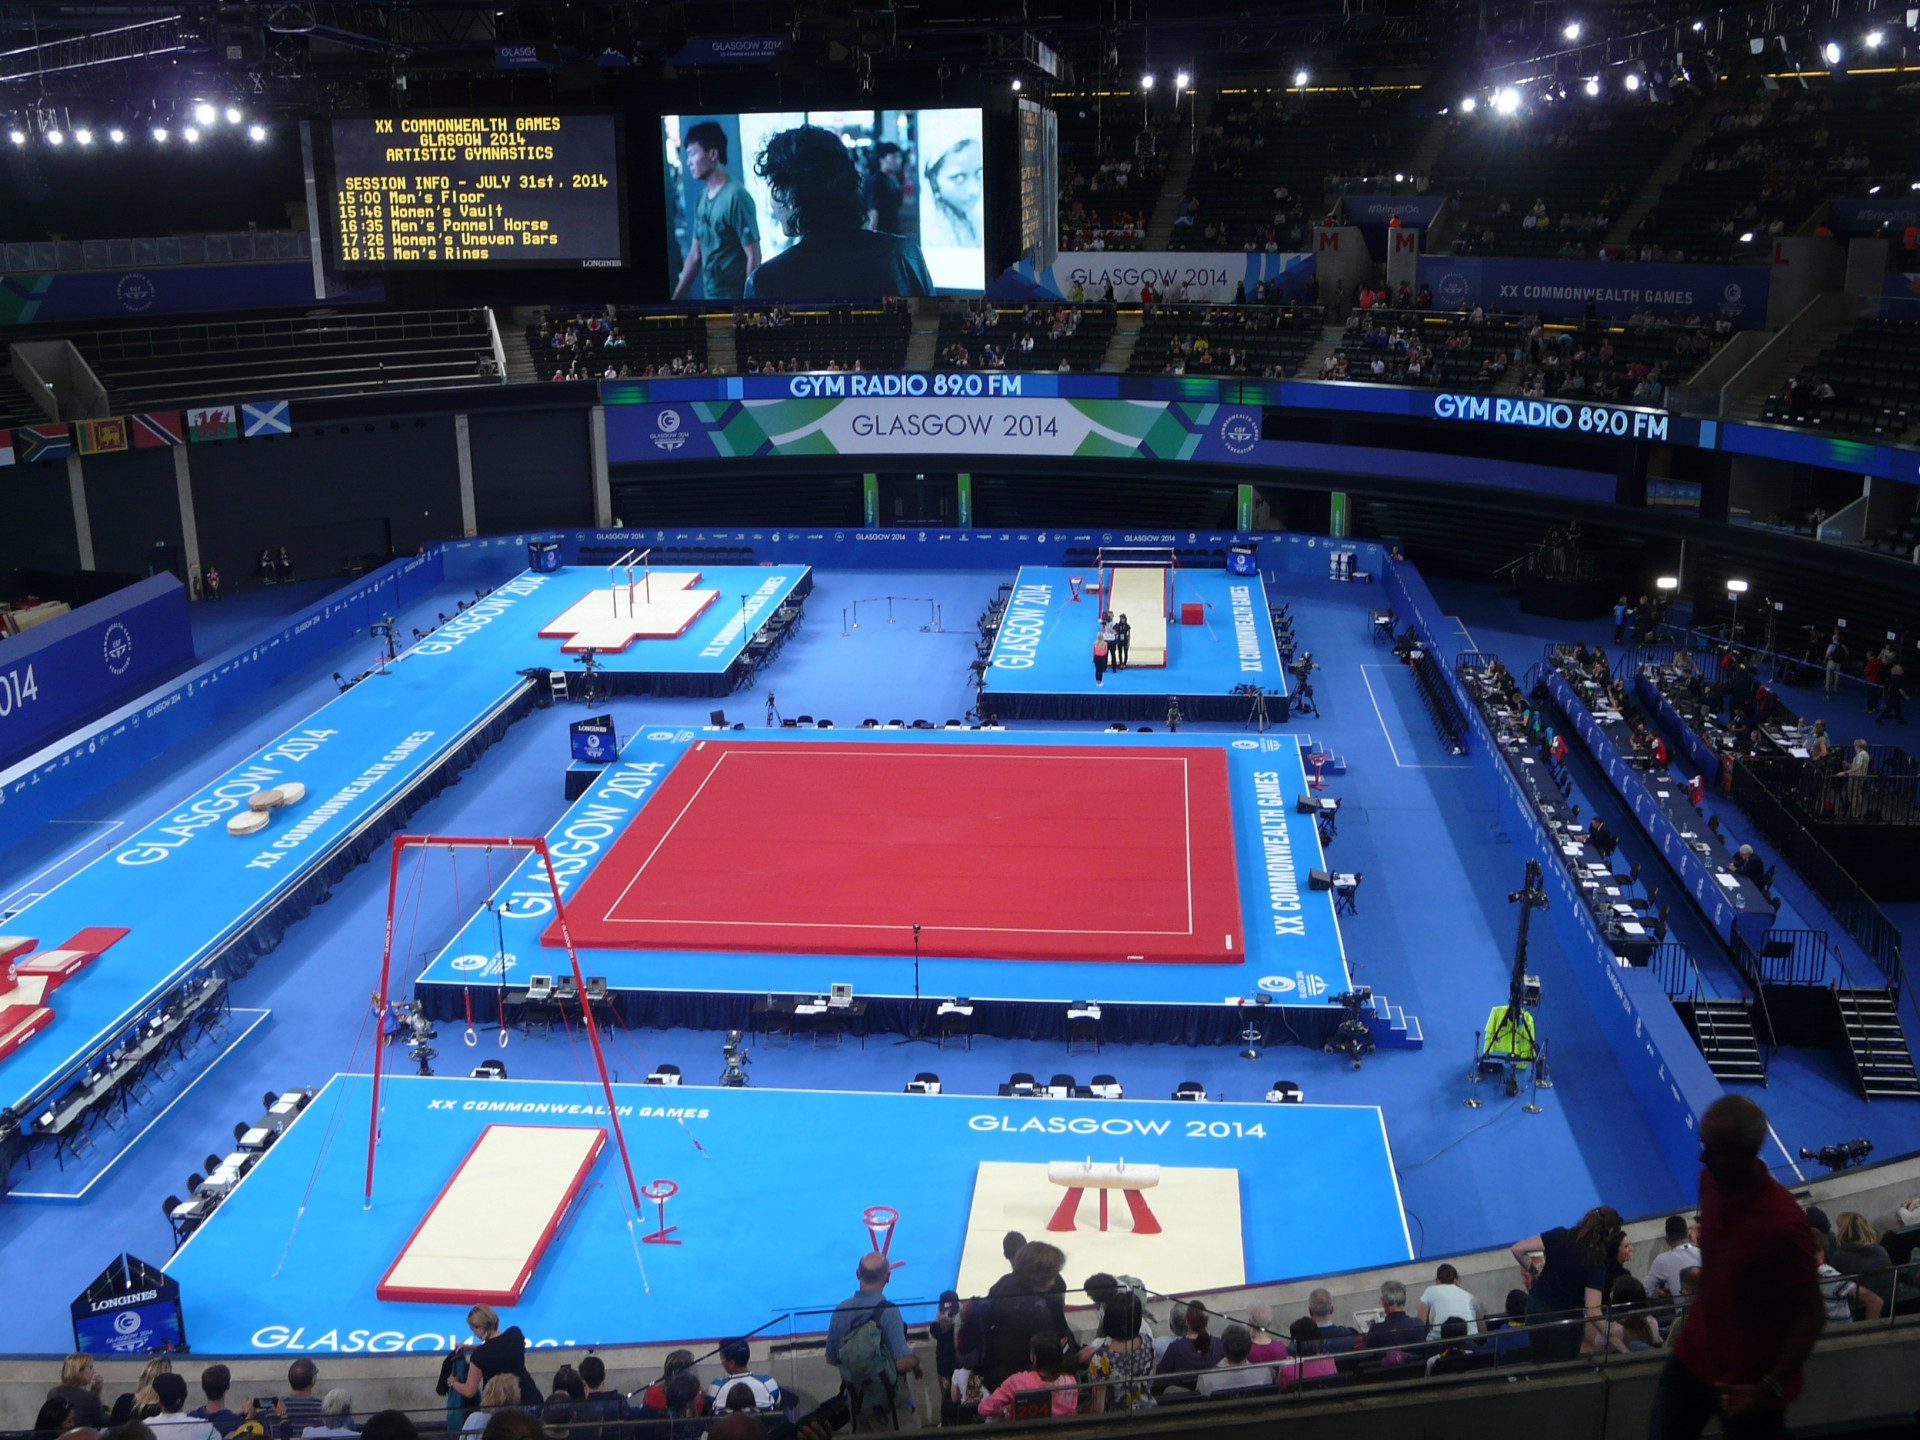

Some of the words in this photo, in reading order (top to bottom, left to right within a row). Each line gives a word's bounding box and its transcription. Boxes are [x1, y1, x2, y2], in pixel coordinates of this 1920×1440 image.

[375, 120, 393, 133] XX
[401, 118, 507, 133] COMMONWEALTH
[516, 117, 561, 131] GAMES
[420, 133, 482, 147] GLASGOW
[490, 132, 526, 146] 2014
[386, 147, 456, 162] ARTISTIC
[465, 146, 553, 160] GYMNASTICS
[345, 176, 406, 190] SESSION
[415, 175, 449, 189] INFO
[475, 175, 511, 189] JULY
[572, 174, 608, 188] 2014
[338, 191, 381, 204] 15:00
[389, 190, 433, 204] Men's
[441, 190, 485, 203] Floor
[339, 205, 382, 219] 15:46
[390, 205, 451, 218] Women's
[460, 204, 503, 218] Vault
[341, 219, 383, 233] 16:35
[392, 219, 435, 232] Men's
[443, 218, 494, 231] Pommel
[504, 218, 549, 231] Horse
[341, 233, 384, 246] 17:26
[392, 232, 453, 246] Women's
[461, 232, 513, 245] Uneven
[522, 231, 558, 245] Bars
[1320, 232, 1338, 250] M
[1395, 233, 1415, 253] M
[343, 247, 385, 260] 18:15
[393, 247, 437, 260] Men's
[445, 246, 489, 260] Rings
[582, 259, 622, 267] LONGINES
[1774, 242, 1789, 264] L
[1071, 268, 1182, 286] GLASGOW
[1186, 269, 1228, 286] 2014
[1500, 284, 1519, 299] XX
[1523, 285, 1640, 304] COMMONWEALTH
[1643, 289, 1694, 305] GAMES
[789, 373, 845, 398] GYM
[851, 373, 929, 397] RADIO
[933, 373, 983, 397] 89.0
[988, 375, 1022, 397] FM
[852, 413, 993, 438] GLASGOW
[1003, 414, 1059, 438] 2014
[1434, 394, 1490, 421] GYM
[1495, 399, 1573, 430] RADIO
[1578, 407, 1629, 436] 89.0
[1634, 413, 1669, 441] FM
[596, 532, 629, 540] GLASGOW
[631, 532, 645, 540] 2014
[856, 533, 890, 541] GLASGOW
[891, 533, 906, 541] 2014
[1124, 534, 1160, 542] GLASGOW
[1161, 534, 1176, 542] 2014
[416, 596, 514, 656] GLASGOW
[498, 575, 551, 597] 2014
[993, 614, 1046, 669] GLASGOW
[1021, 583, 1053, 612] 2014
[147, 699, 171, 719] GLASGOW
[115, 766, 283, 866] GLASGOW
[263, 728, 339, 762] 2014
[1253, 771, 1284, 807] GAMES
[245, 852, 287, 870] XX
[272, 762, 396, 850] COMMONWEALTH
[382, 730, 436, 762] GAMES
[499, 804, 628, 919] GLASGOW
[598, 761, 665, 800] 2014
[1259, 809, 1302, 911] COMMONWEALTH
[1273, 915, 1306, 936] XX
[426, 1099, 458, 1111] XX
[462, 1100, 633, 1117] COMMONWEALTH
[639, 1106, 711, 1120] GAMES
[968, 1114, 1172, 1137] GLASGOW
[1185, 1120, 1267, 1139] 2014
[91, 1289, 158, 1312] LONGINES
[1018, 1403, 1050, 1418] 204
